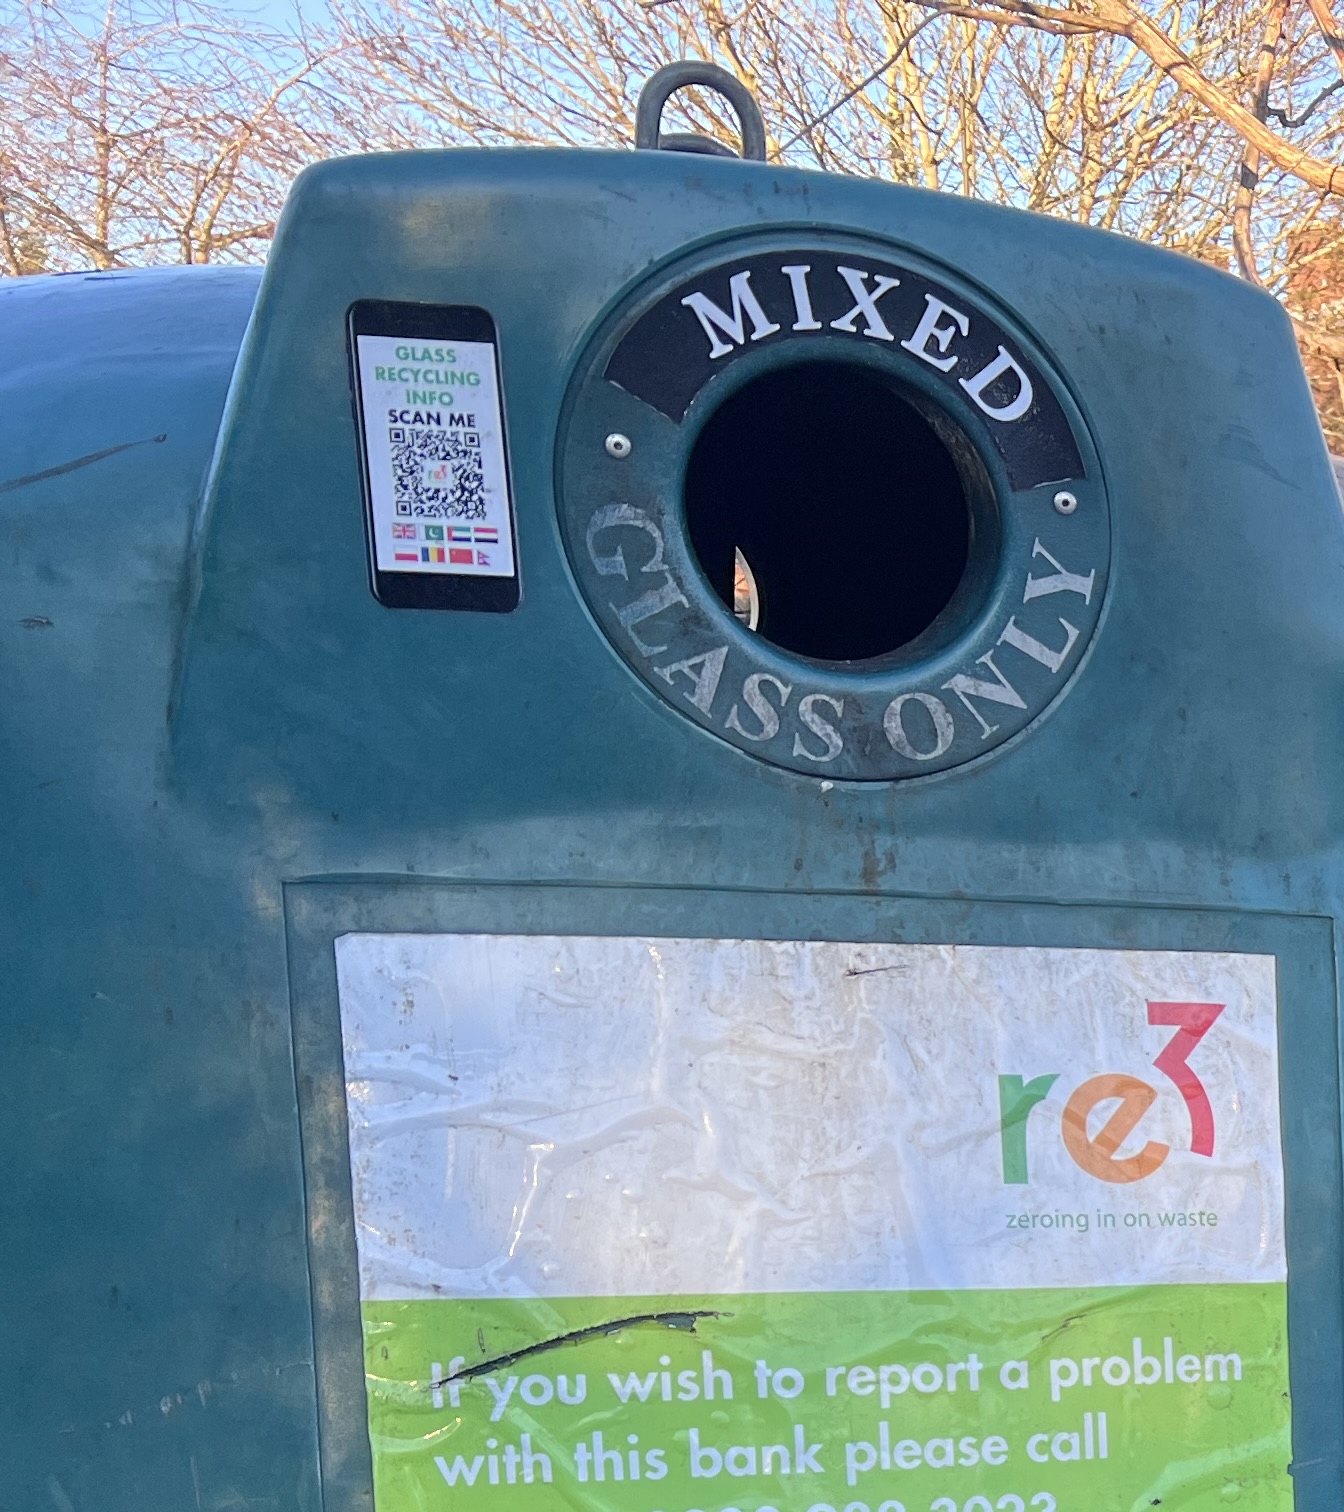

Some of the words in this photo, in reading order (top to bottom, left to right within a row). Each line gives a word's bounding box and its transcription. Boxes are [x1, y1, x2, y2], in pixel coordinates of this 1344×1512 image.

[395, 346, 457, 364] GLASS
[682, 264, 1035, 422] MIXED
[375, 366, 481, 387] RECYCLING
[406, 389, 454, 406] INFO
[388, 409, 441, 427] SCAN
[449, 412, 477, 428] ME
[586, 503, 846, 762] GLASS
[884, 537, 1097, 762] ONLY
[998, 1000, 1228, 1185] re3
[1005, 1208, 1090, 1232] zeroing
[1097, 1208, 1116, 1228] in
[1123, 1212, 1151, 1228] on
[1157, 1210, 1219, 1228] waste
[430, 1355, 465, 1409] If
[485, 1373, 588, 1422] you
[607, 1350, 733, 1403] wish
[754, 1359, 805, 1399] to
[825, 1353, 983, 1409] report
[1000, 1360, 1029, 1390] a
[1049, 1336, 1243, 1402] problem
[433, 1432, 553, 1487] with
[573, 1431, 668, 1482] this
[689, 1424, 825, 1479] bank
[845, 1420, 1009, 1486] please
[1025, 1411, 1109, 1463] call
